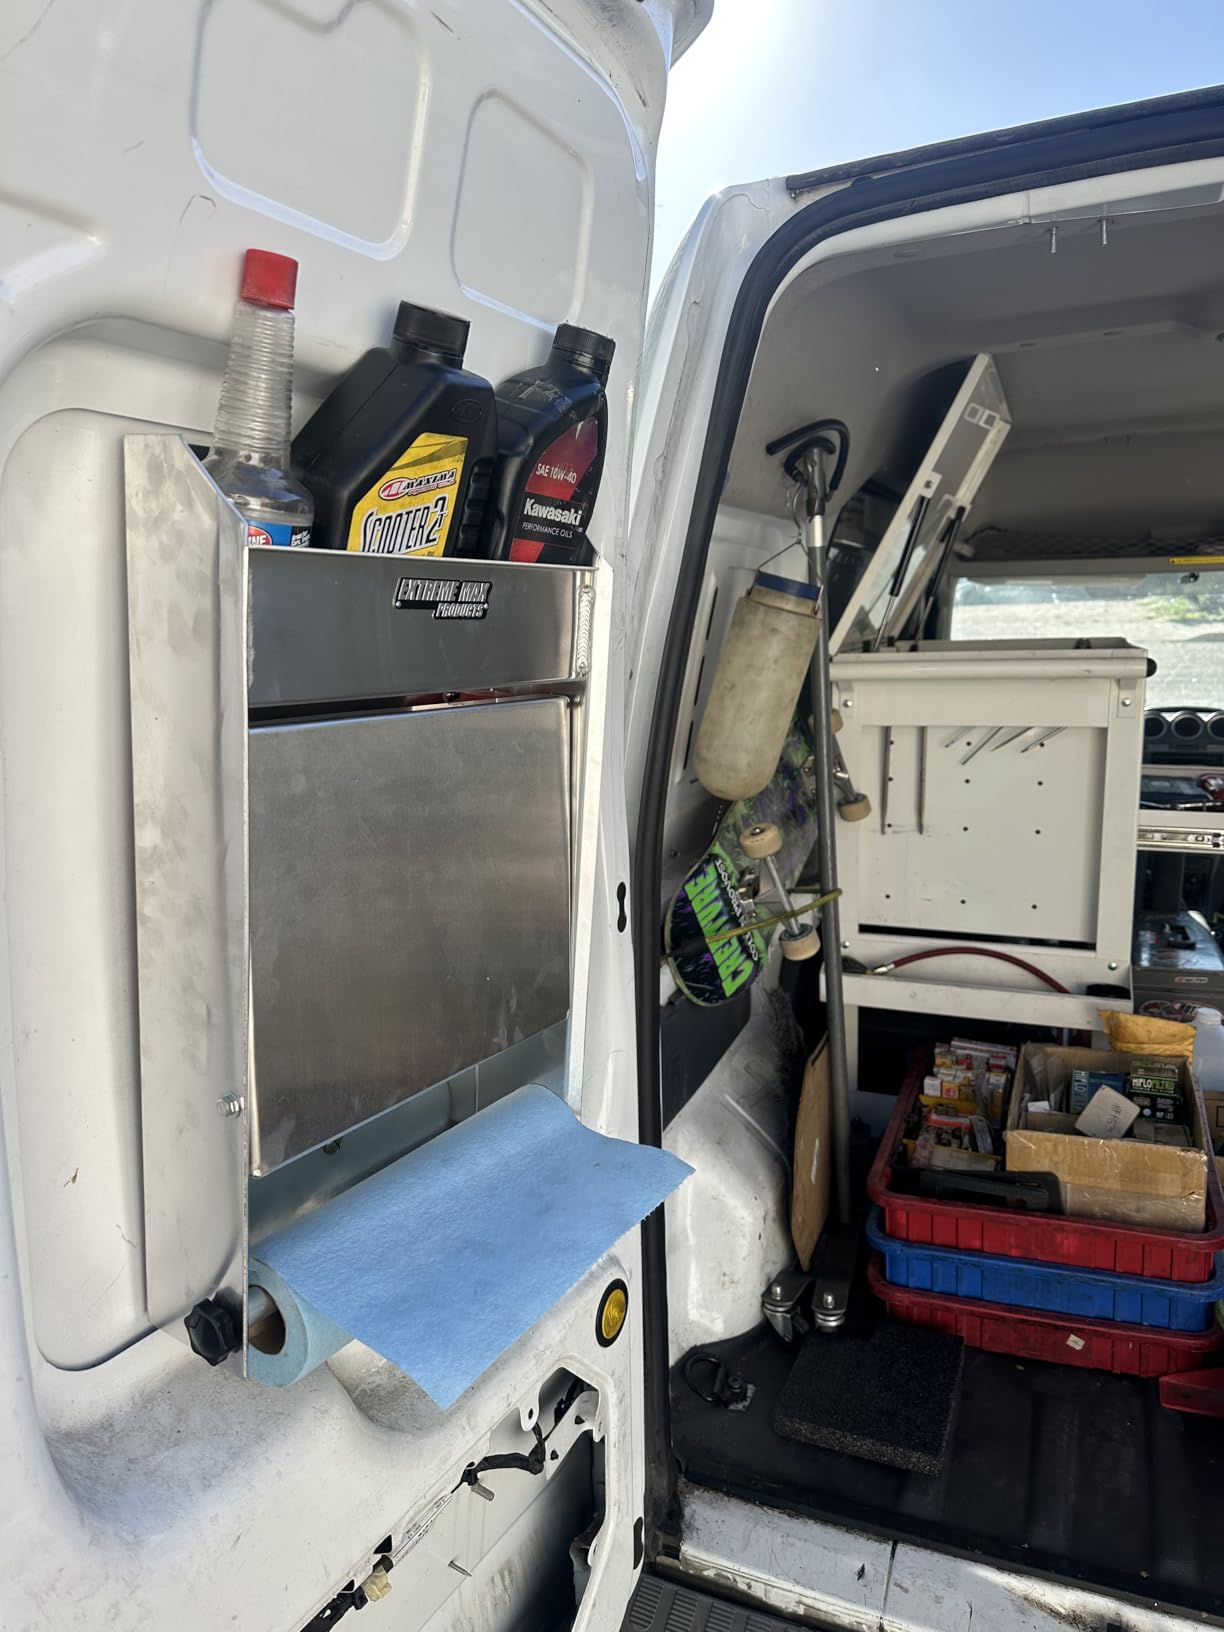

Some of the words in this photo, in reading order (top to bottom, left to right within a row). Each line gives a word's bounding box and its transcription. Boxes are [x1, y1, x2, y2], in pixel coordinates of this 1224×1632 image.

[536, 463, 549, 478] SAE
[550, 466, 577, 484] 10W-40
[523, 497, 583, 526] Kawasaki
[362, 504, 430, 552] SCOOTER
[522, 521, 559, 536] PERFORMANCE
[559, 528, 573, 538] OILS
[397, 578, 460, 601] EXTREME
[458, 581, 491, 602] MAX
[435, 602, 485, 618] PRODUCTS
